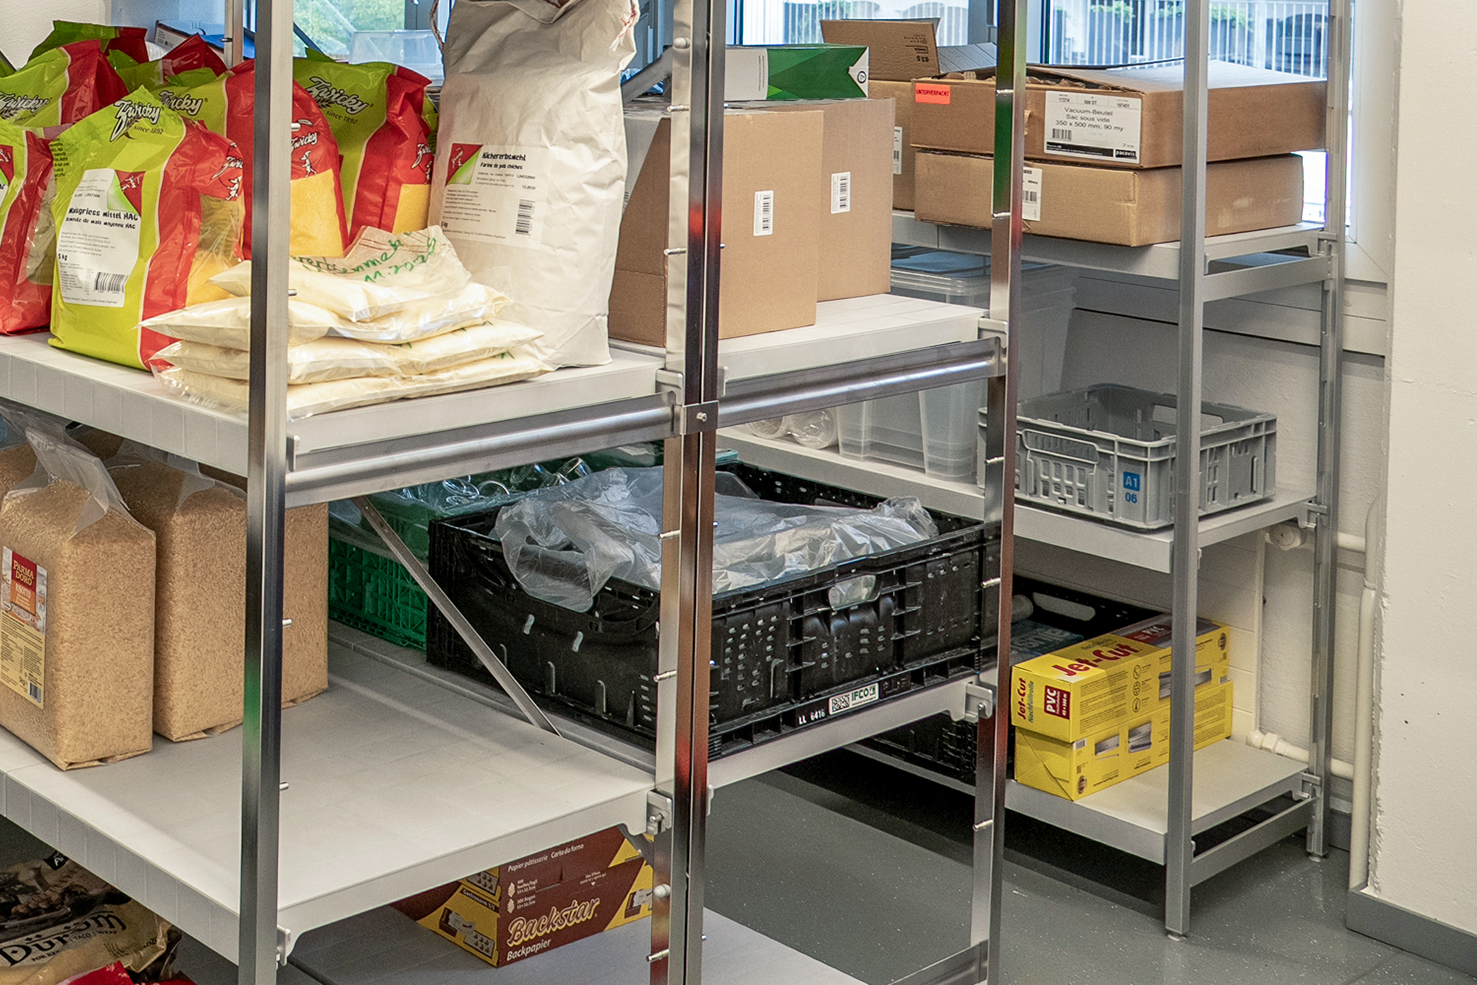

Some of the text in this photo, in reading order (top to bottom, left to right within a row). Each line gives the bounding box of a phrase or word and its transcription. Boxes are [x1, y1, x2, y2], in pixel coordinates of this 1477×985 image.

[307, 76, 369, 115] Zwicky
[112, 99, 162, 132] Zwicky
[327, 110, 358, 124] since 1892
[1065, 107, 1113, 116] Vacuum-Beutel
[133, 125, 164, 135] since 1892
[103, 210, 121, 219] mittel
[1125, 476, 1137, 488] A1
[1125, 492, 1137, 503] 06
[13, 559, 34, 579] PARMA
[15, 571, 32, 587] DORO
[1144, 624, 1167, 637] PVC
[1052, 643, 1139, 677] Jet-Cut
[852, 689, 868, 701] IFCO
[1017, 677, 1027, 720] Jet-Cut
[1046, 688, 1057, 713] PVC
[798, 715, 806, 725] LL
[508, 862, 524, 872] Papier
[524, 855, 548, 869] pâtisserie
[571, 843, 584, 852] forno
[506, 897, 600, 947] Backstar
[506, 939, 551, 961] Backpapier
